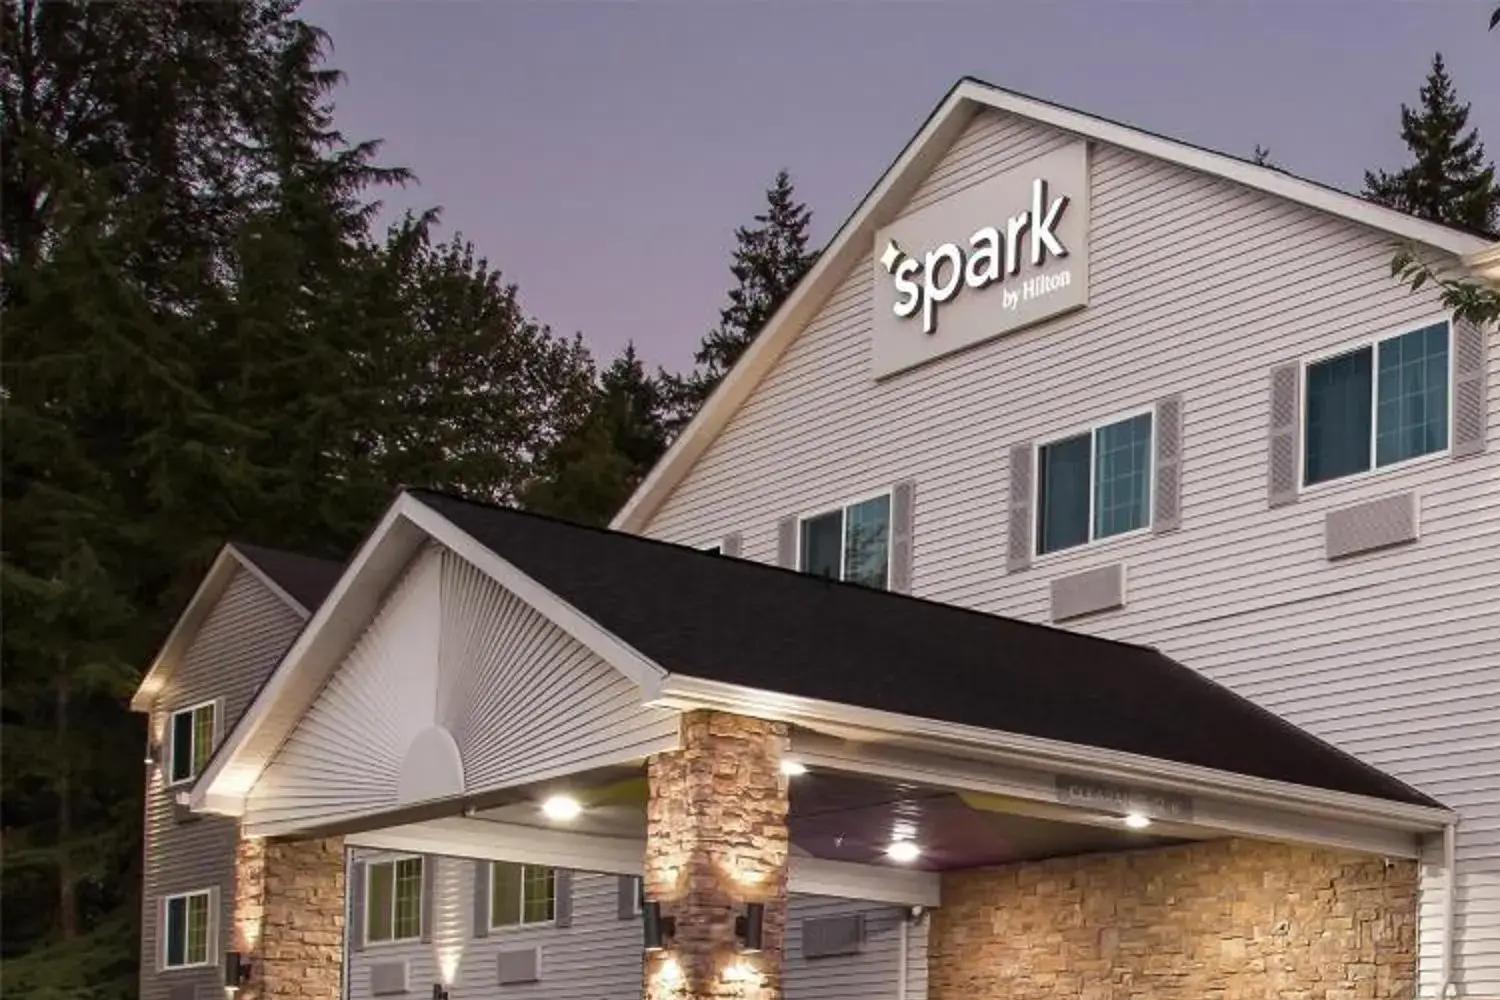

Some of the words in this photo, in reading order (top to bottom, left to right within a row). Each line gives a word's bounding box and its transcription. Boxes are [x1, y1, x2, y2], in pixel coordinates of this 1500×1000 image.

[892, 178, 1070, 334] spark
[1002, 287, 1020, 310] by
[1023, 270, 1070, 300] Hilton
